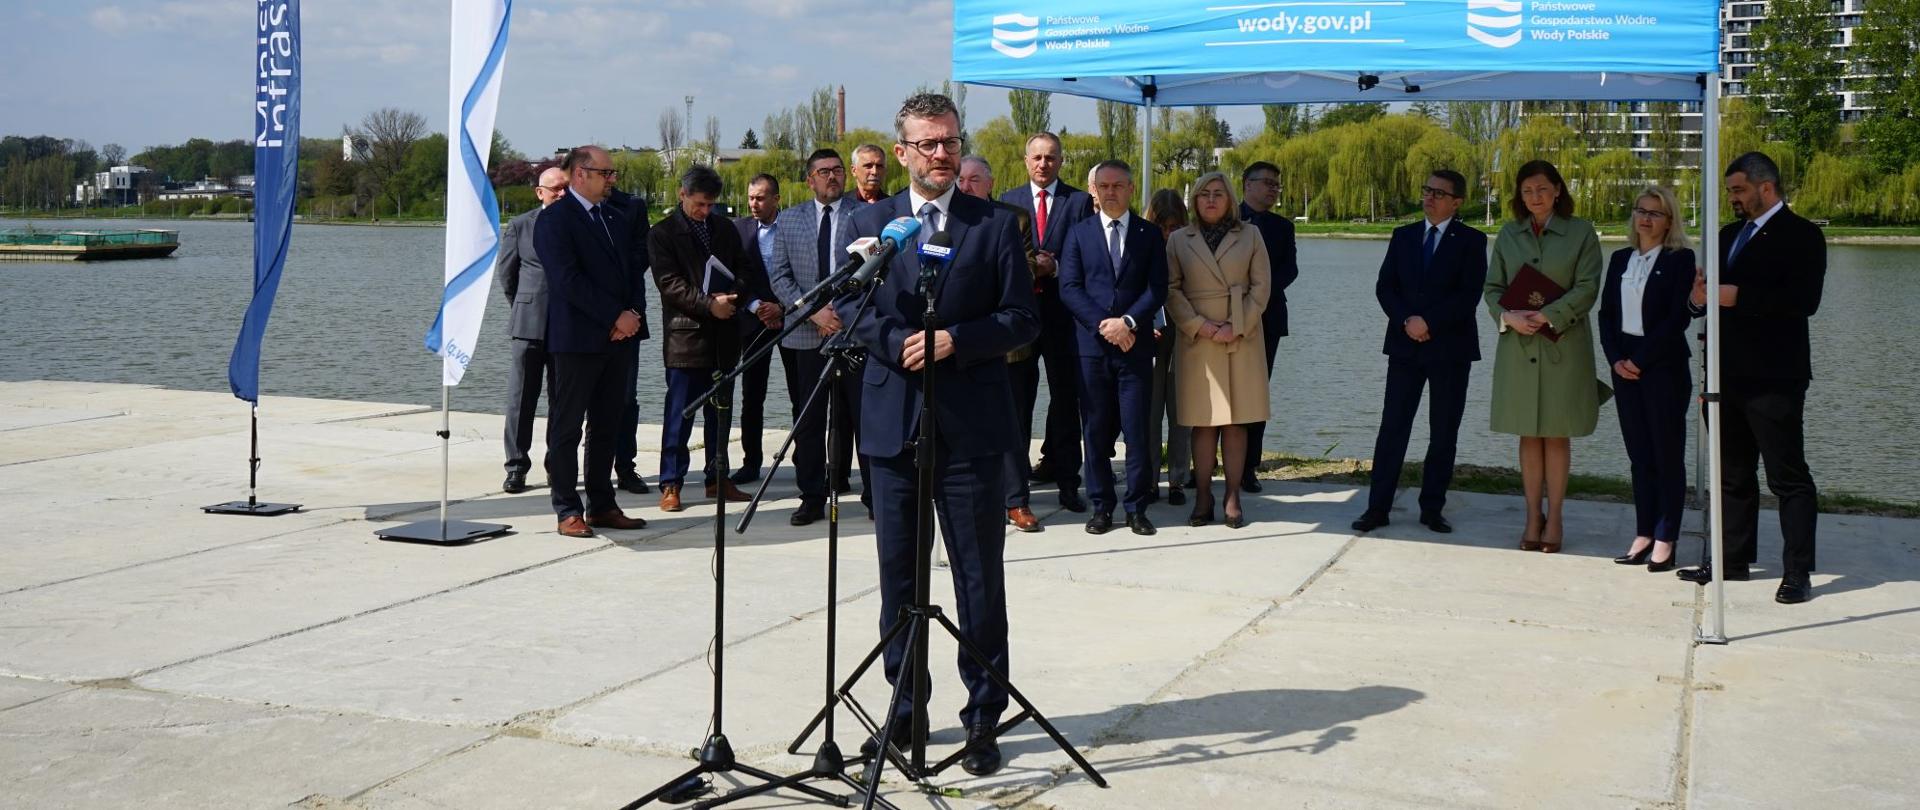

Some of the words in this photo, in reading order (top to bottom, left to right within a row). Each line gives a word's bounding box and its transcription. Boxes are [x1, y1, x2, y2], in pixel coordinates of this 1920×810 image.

[1531, 0, 1596, 11] Państwowe
[1046, 15, 1100, 25] Państwowe
[1237, 10, 1371, 34] wody.gov.pl
[1531, 15, 1613, 28] Gospodarstwo
[1616, 14, 1657, 25] Wodne
[1045, 26, 1113, 38] Gospodarstwo
[1115, 23, 1149, 34] Wodne
[1531, 30, 1565, 42] Wody
[1568, 29, 1610, 40] Polskie
[1045, 40, 1074, 51] Wody
[1076, 38, 1111, 49] Polskie
